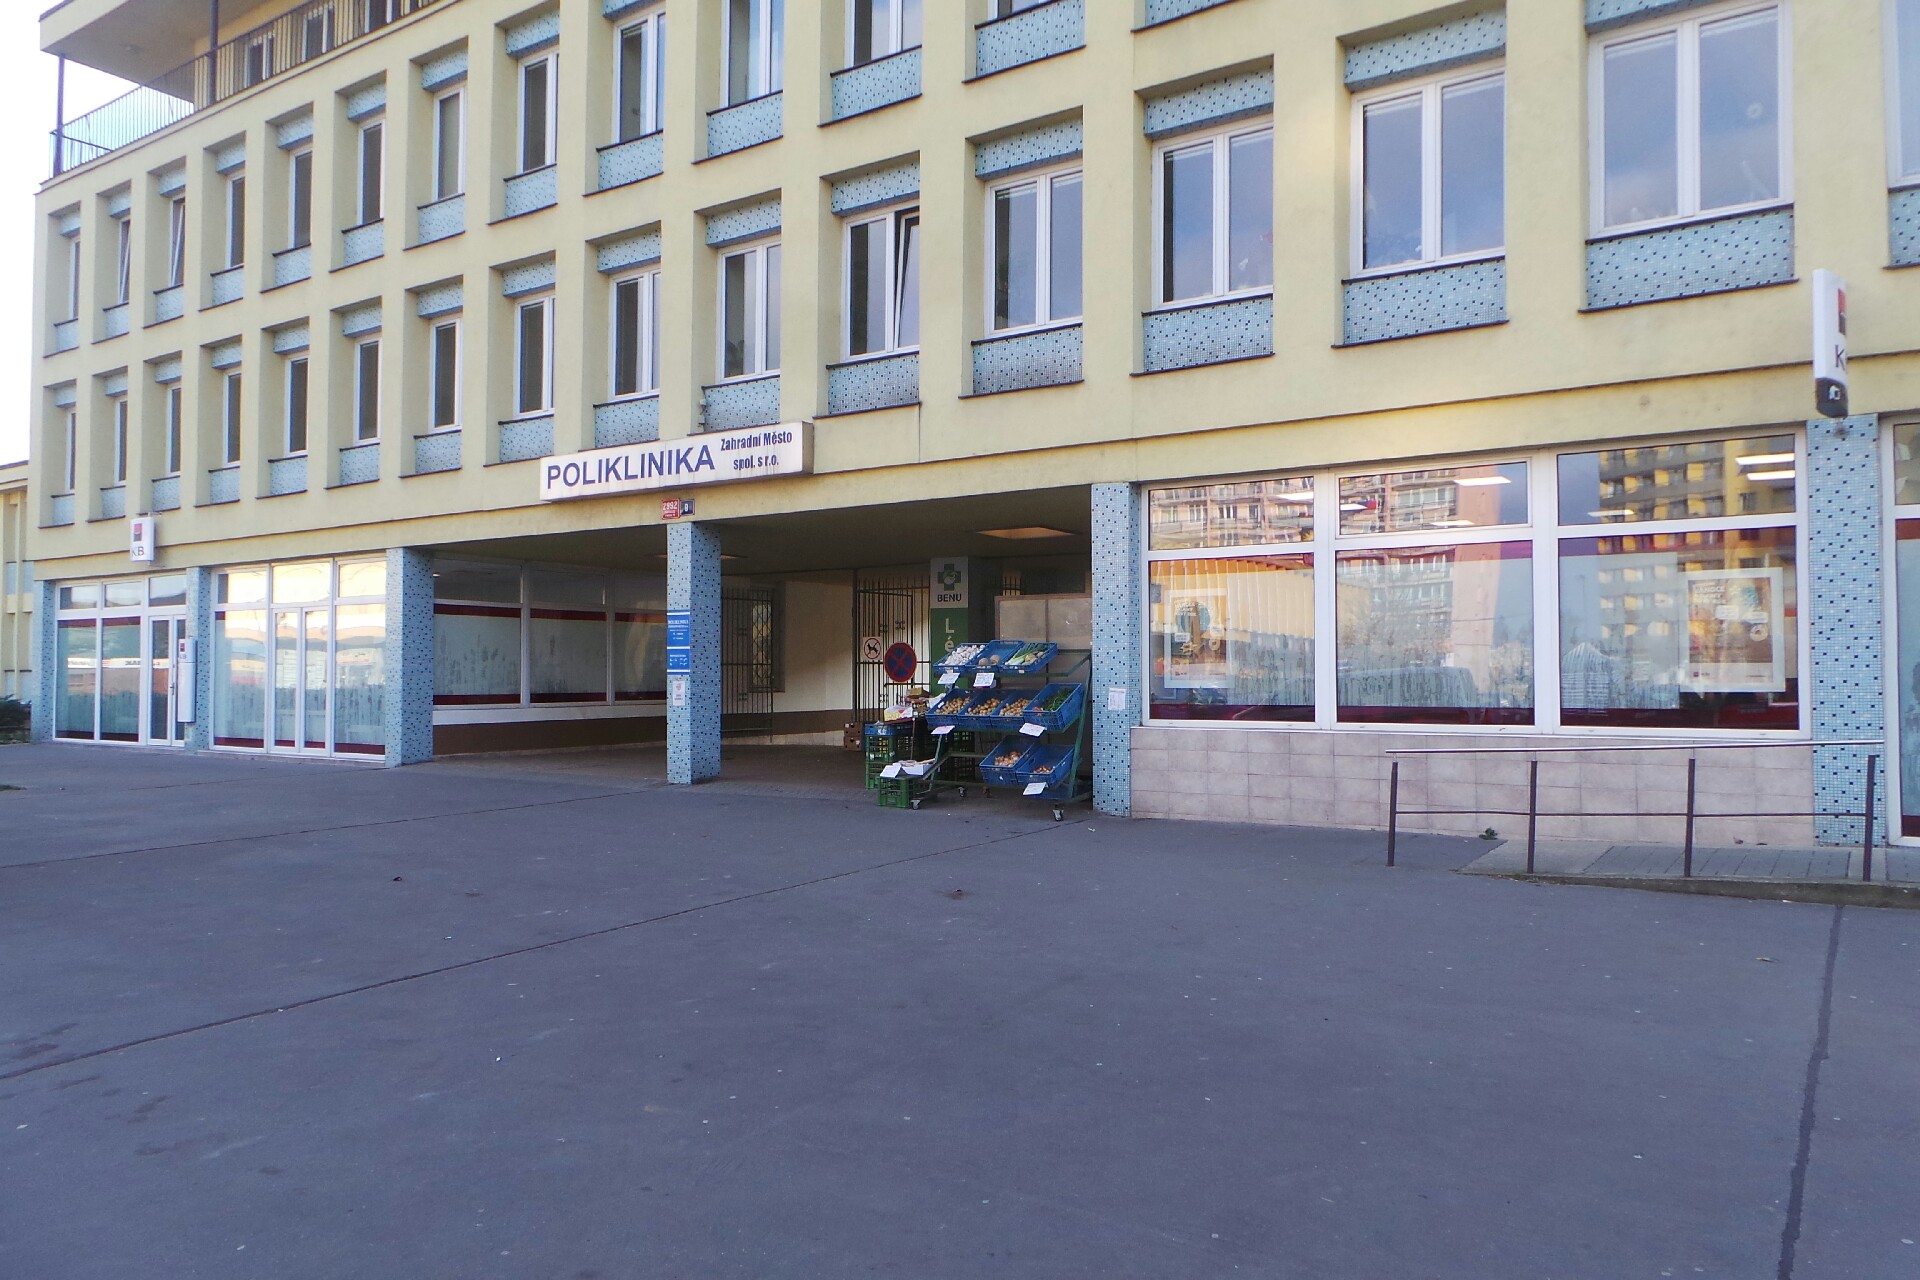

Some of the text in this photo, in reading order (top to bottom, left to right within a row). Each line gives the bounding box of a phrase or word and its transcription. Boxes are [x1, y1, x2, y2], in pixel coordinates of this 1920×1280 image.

[720, 430, 793, 452] Zahradní Město
[547, 444, 716, 490] POLIKLINIKA
[733, 454, 779, 471] spol. s r.o.
[662, 501, 678, 511] 2992
[937, 593, 962, 603] BENU
